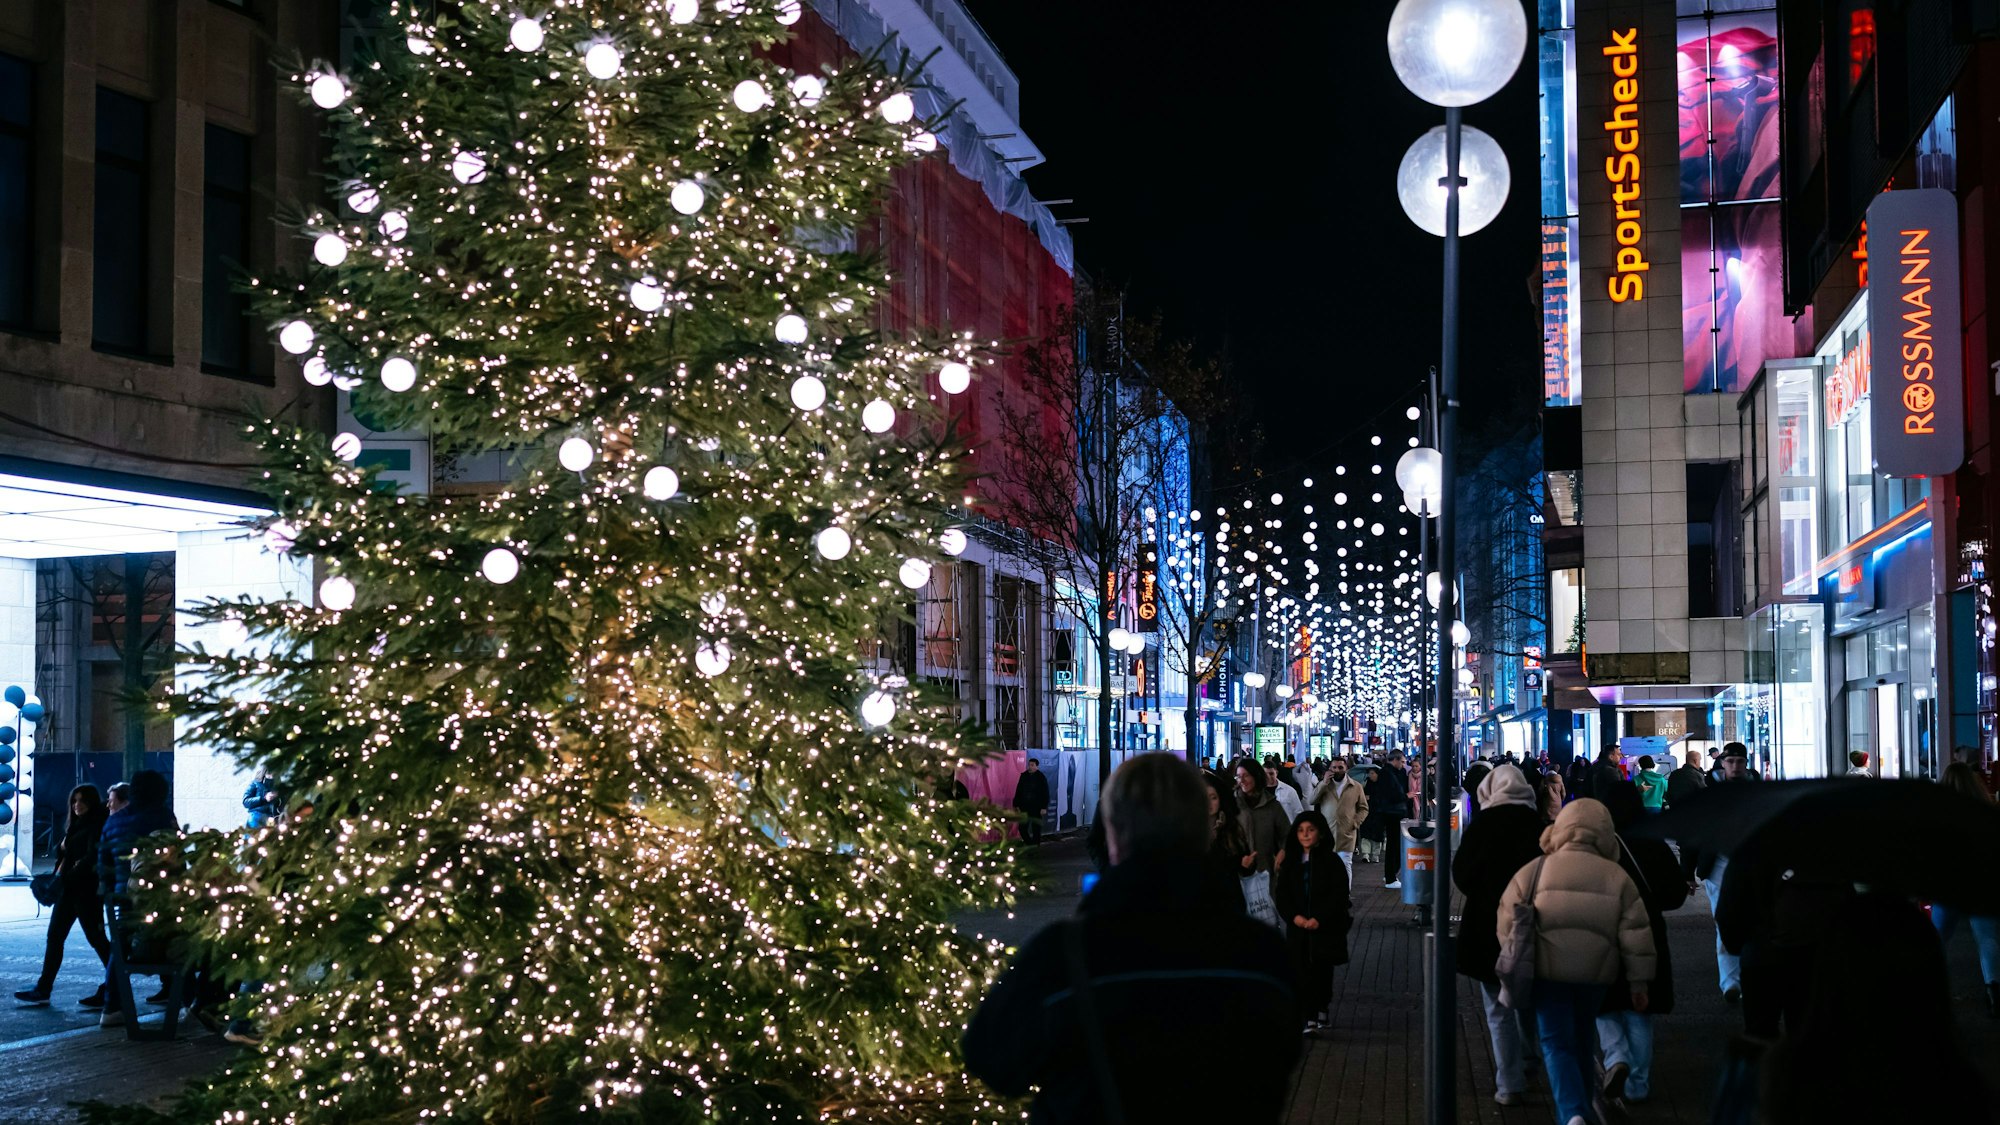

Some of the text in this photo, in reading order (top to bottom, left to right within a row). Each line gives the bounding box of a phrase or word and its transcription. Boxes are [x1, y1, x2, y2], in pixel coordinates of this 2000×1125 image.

[1602, 27, 1649, 303] SportScheck
[1901, 228, 1935, 434] ROSSMANN
[1219, 660, 1227, 704] SEPHORA
